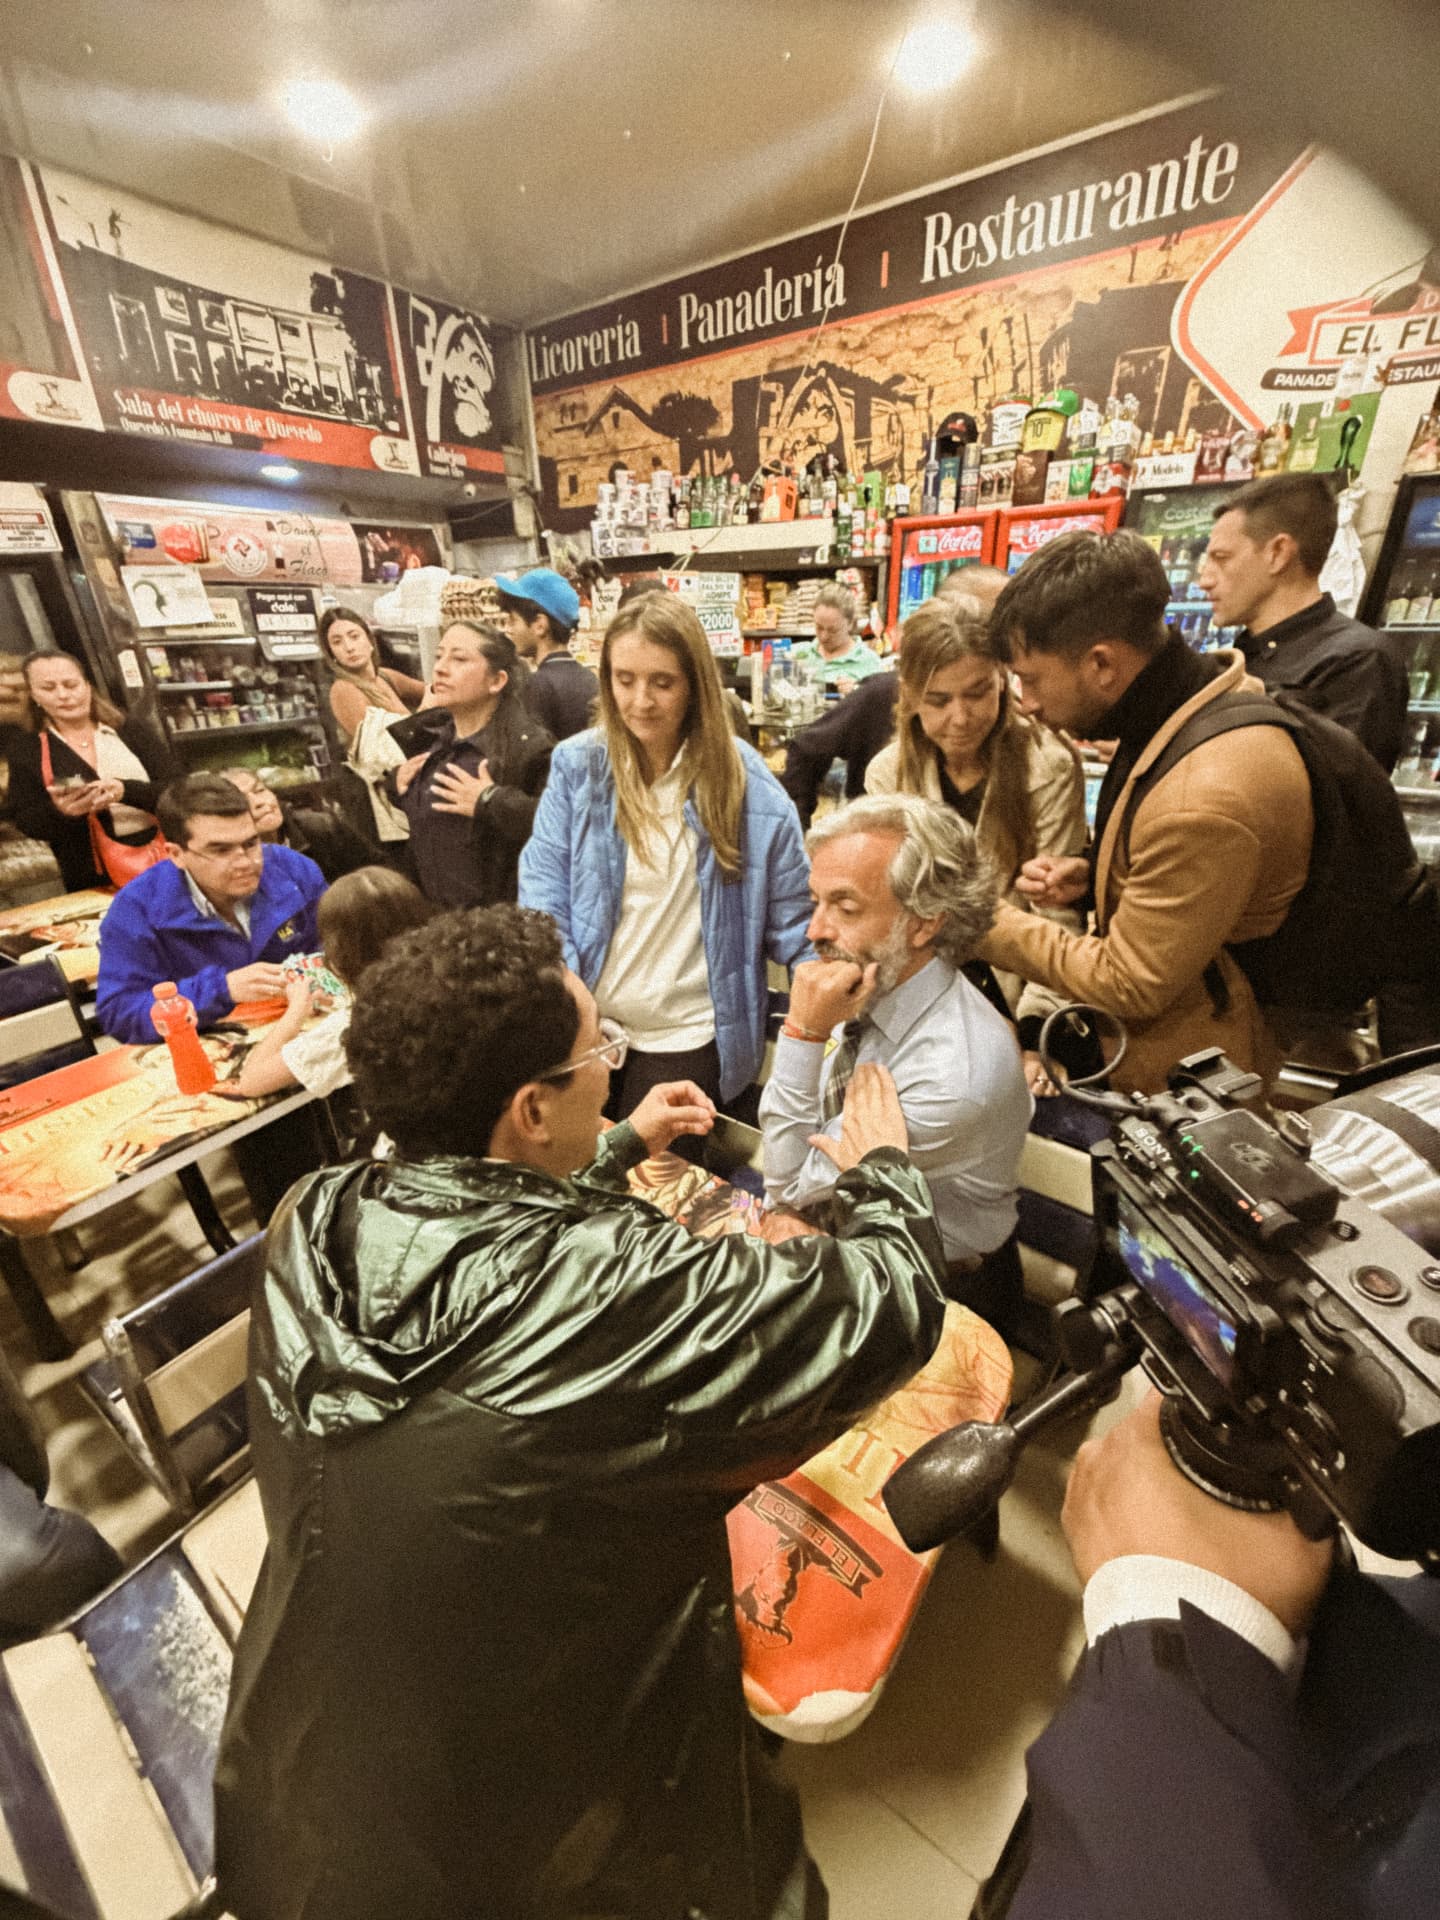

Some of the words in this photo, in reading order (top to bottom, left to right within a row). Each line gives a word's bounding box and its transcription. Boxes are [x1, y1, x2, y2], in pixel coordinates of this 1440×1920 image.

[920, 134, 1239, 284] Restaurante
[679, 255, 847, 349] Panadería
[528, 313, 642, 384] Licorería
[1336, 324, 1382, 356] EL
[1274, 372, 1336, 388] PANADE
[113, 389, 155, 417] Sala
[158, 398, 183, 423] del
[187, 403, 241, 430] chorro
[245, 415, 262, 434] de
[265, 416, 323, 444] Quevedo
[290, 559, 329, 577] Flaco
[1135, 1127, 1172, 1164] SONY
[826, 1541, 850, 1572] EL
